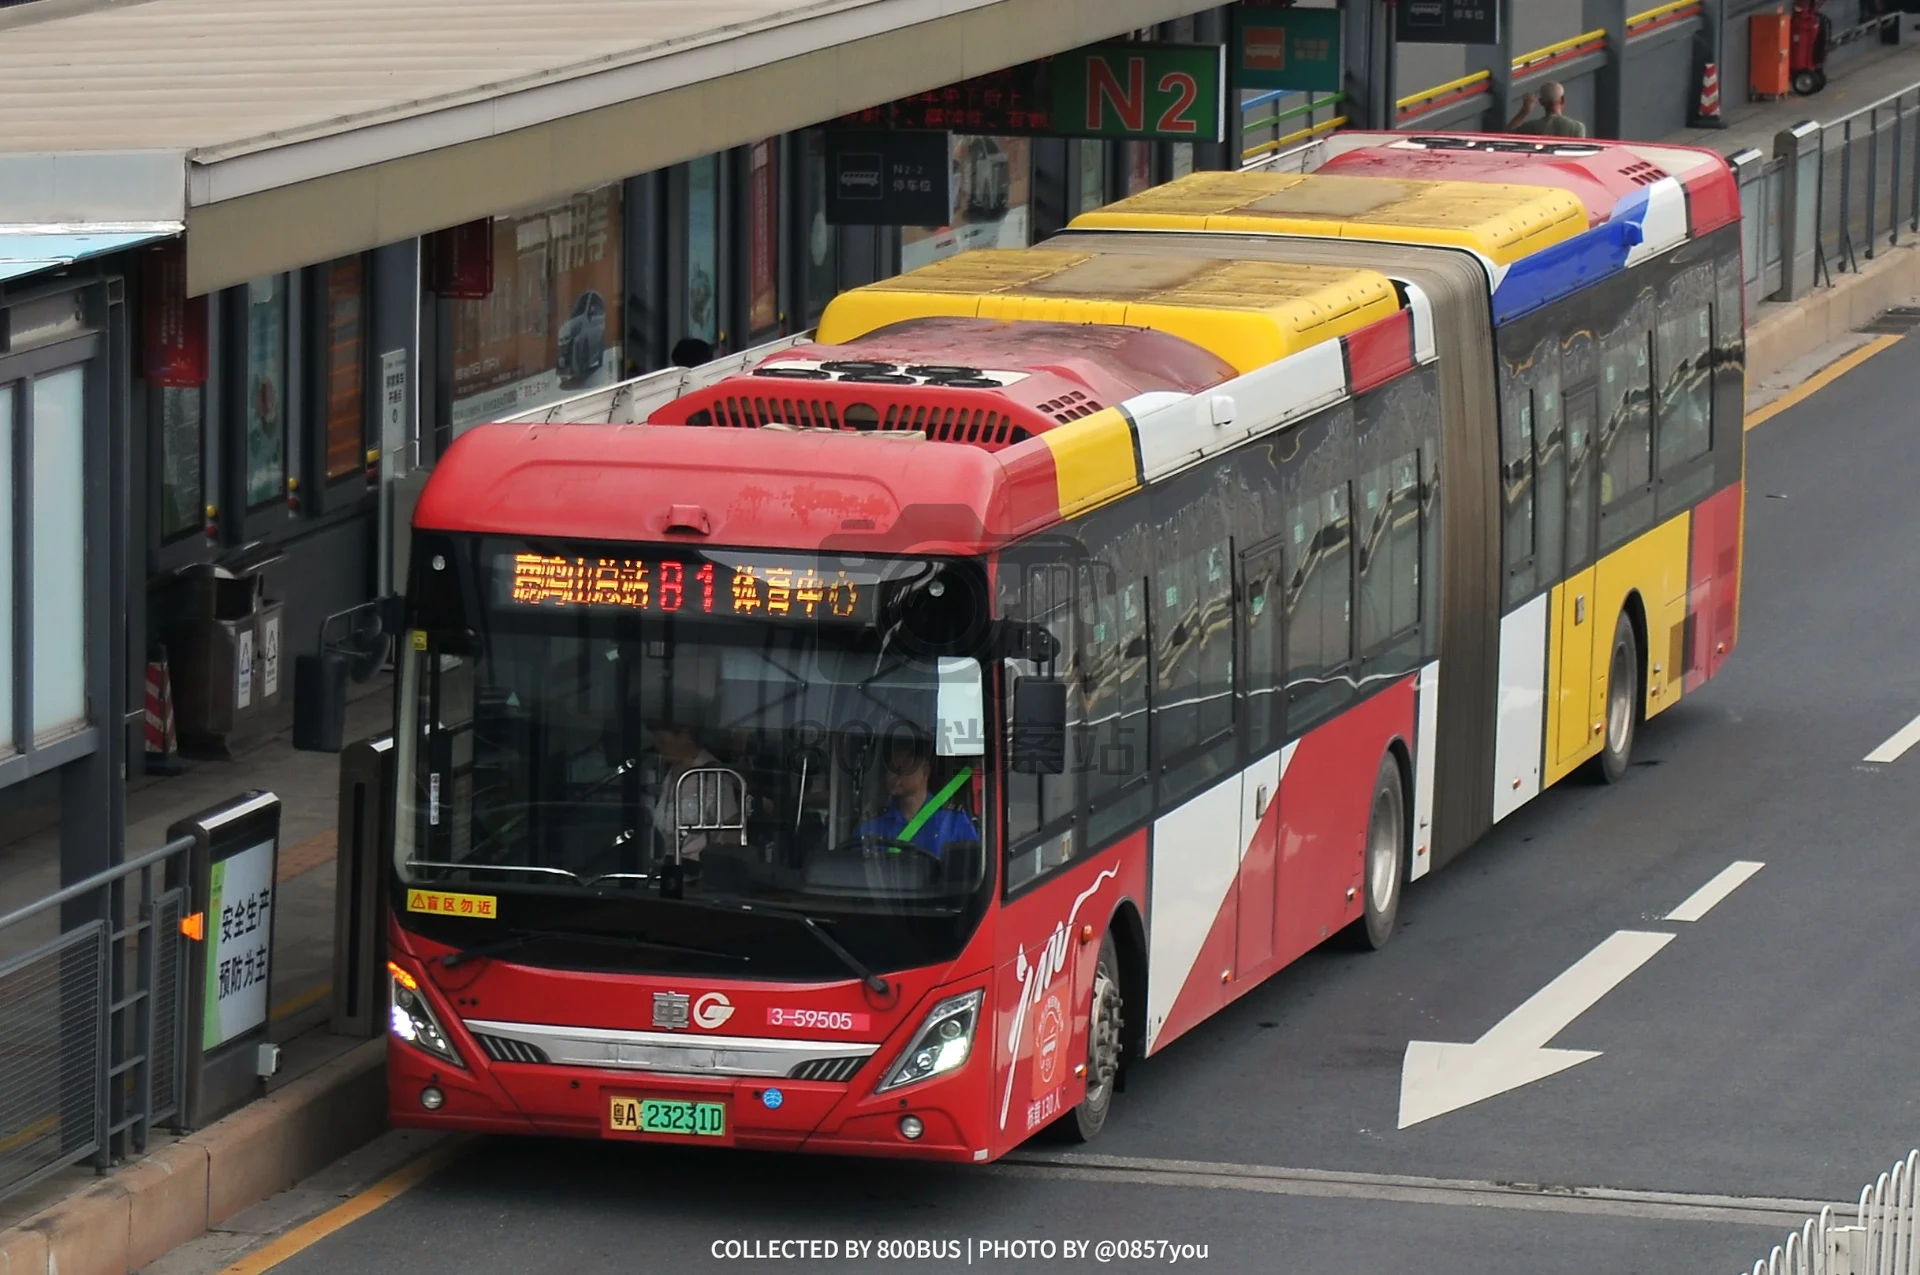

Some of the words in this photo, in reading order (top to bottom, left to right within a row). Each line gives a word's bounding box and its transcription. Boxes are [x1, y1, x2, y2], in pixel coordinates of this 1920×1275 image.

[1086, 56, 1198, 133] N2
[893, 179, 933, 193] 停车位
[731, 563, 858, 618] 体育中心
[222, 888, 269, 944] 安全生产
[422, 895, 491, 914] 盲区勿近
[219, 944, 267, 1000] 预防为主
